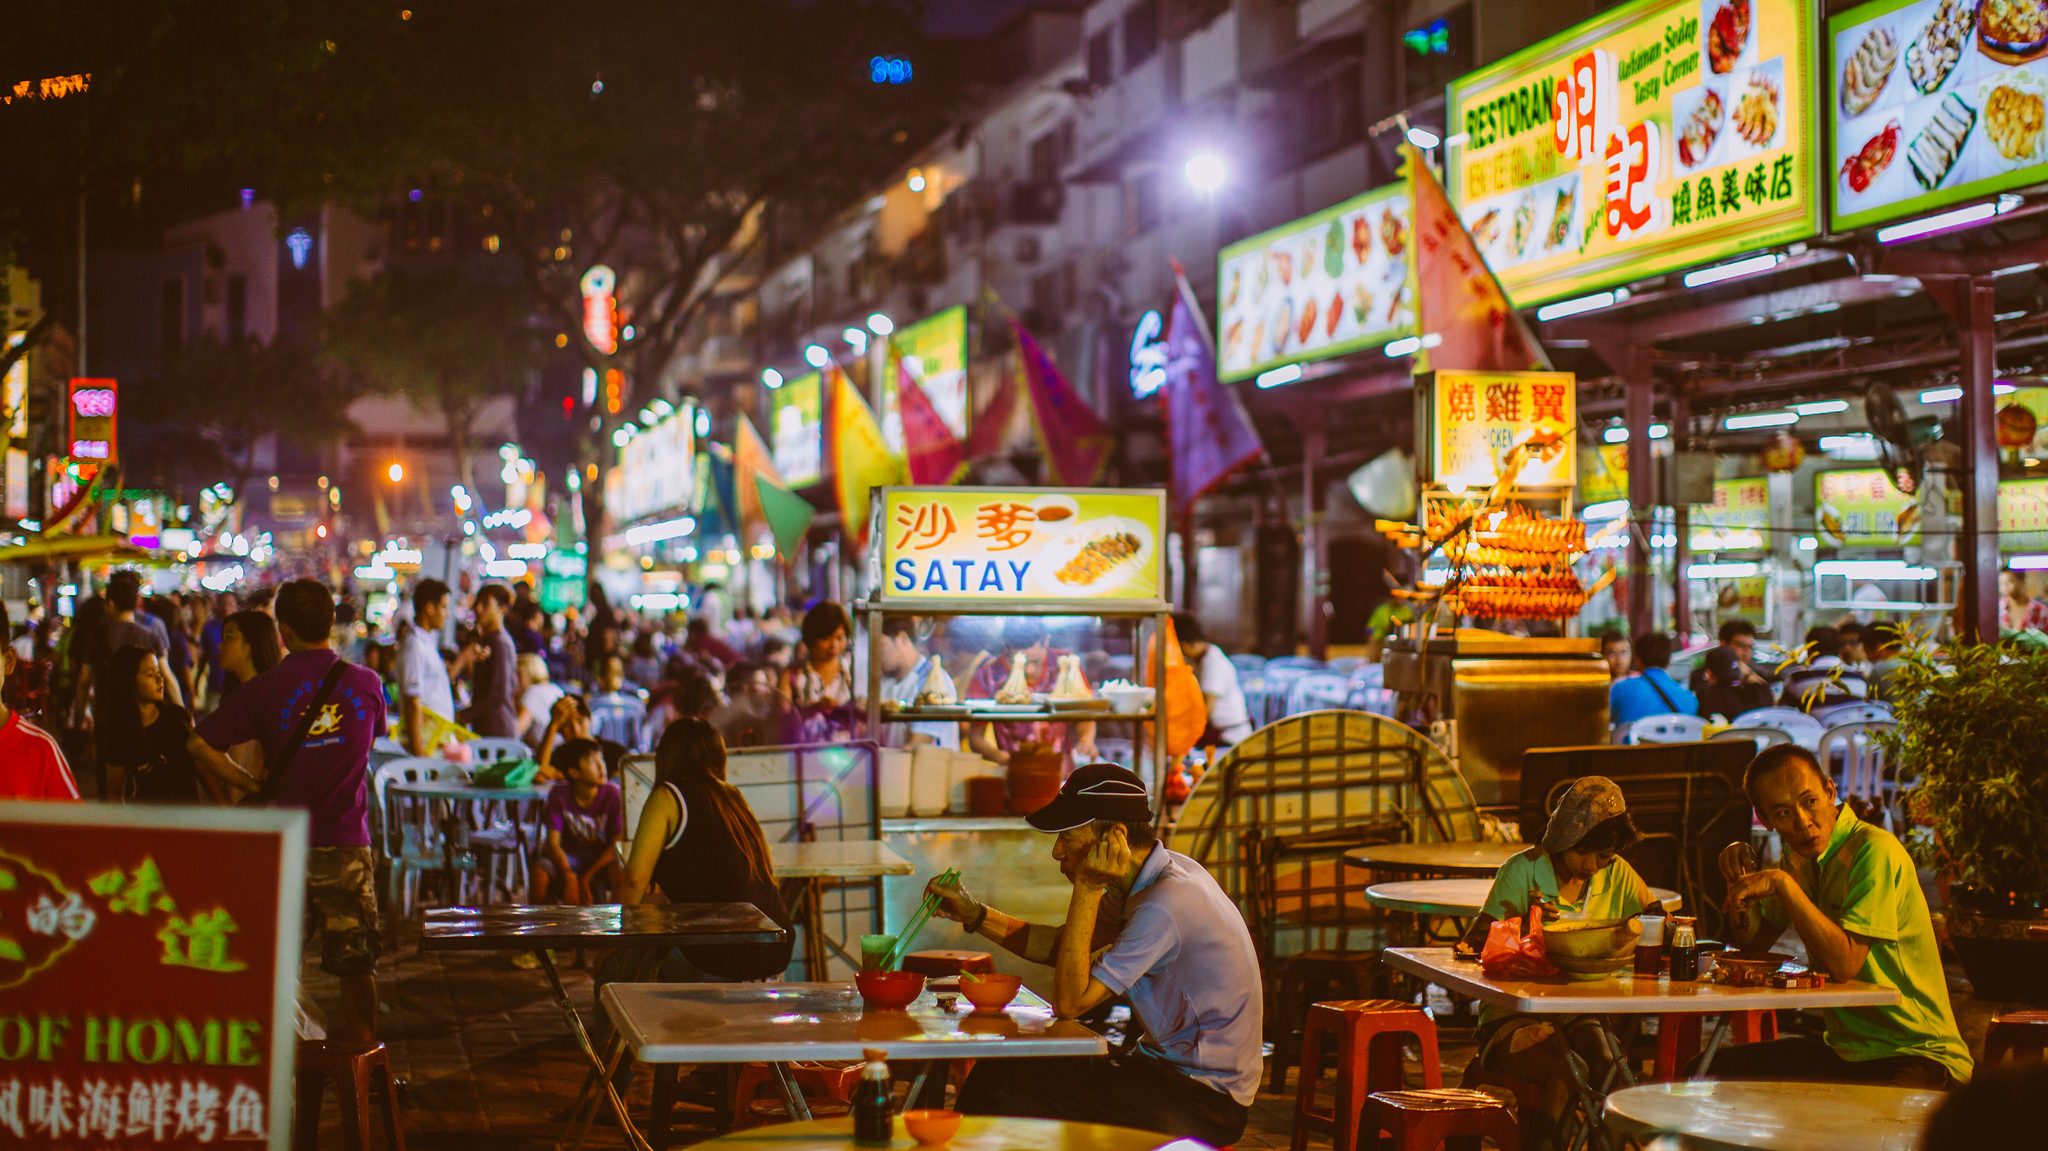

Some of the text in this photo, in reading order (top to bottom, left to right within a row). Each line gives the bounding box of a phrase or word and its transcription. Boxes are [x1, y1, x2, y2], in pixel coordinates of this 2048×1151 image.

[1634, 51, 1699, 105] Tasty Corner
[1467, 74, 1554, 151] RESTORAN
[894, 558, 1031, 592] SATAY
[0, 1016, 261, 1066] OF HOME
